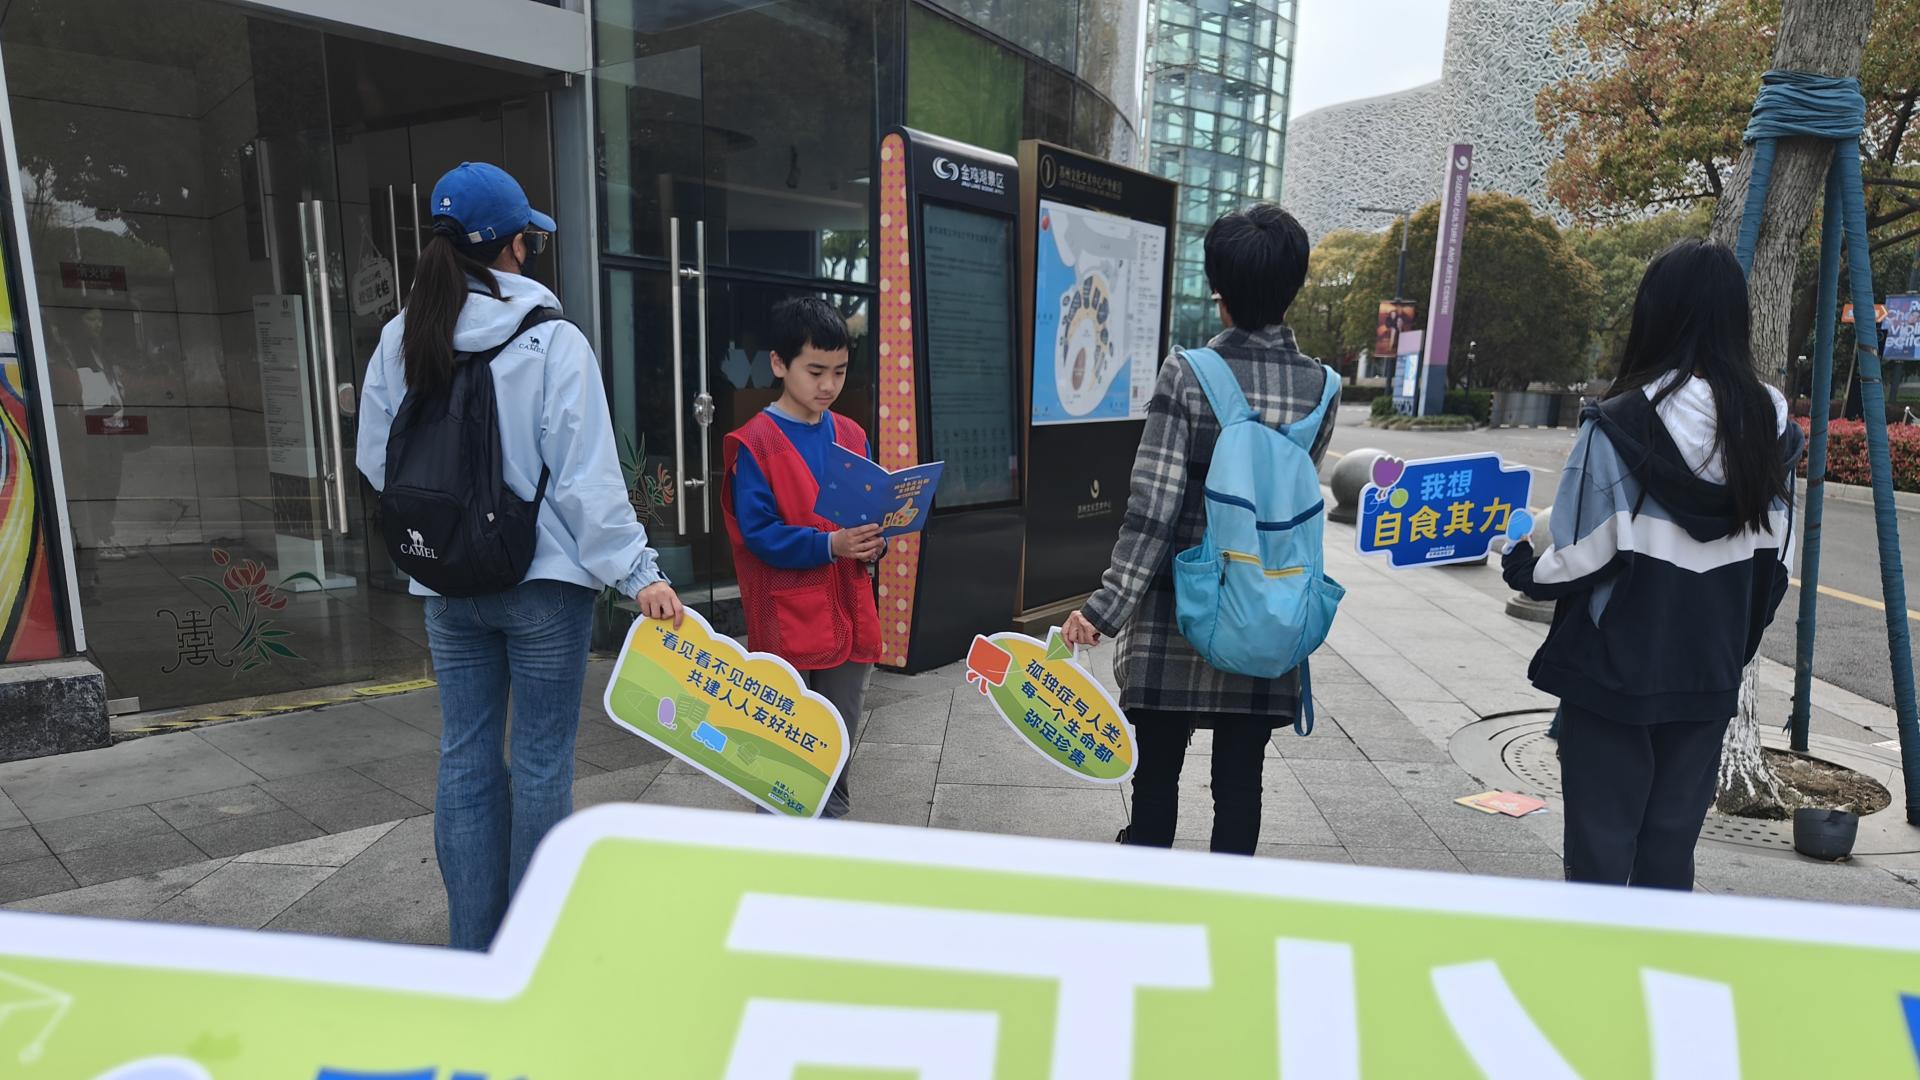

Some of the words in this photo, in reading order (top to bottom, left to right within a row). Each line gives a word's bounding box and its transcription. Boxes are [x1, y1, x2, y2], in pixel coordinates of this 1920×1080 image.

[960, 164, 1005, 189] 金鸡湖景区
[1453, 175, 1464, 207] SUZHOU
[1450, 208, 1461, 244] CULTURE
[1447, 246, 1456, 263] AND
[1444, 264, 1454, 283] ARTS
[1440, 285, 1451, 315] CENTRE
[518, 343, 546, 354] CAMEL
[1420, 469, 1473, 500] 我想
[1373, 497, 1512, 547] 自食其力
[400, 543, 438, 559] CAMEL
[1021, 681, 1114, 763] 每一个生命都
[1023, 708, 1087, 768] 弥足珍贵
